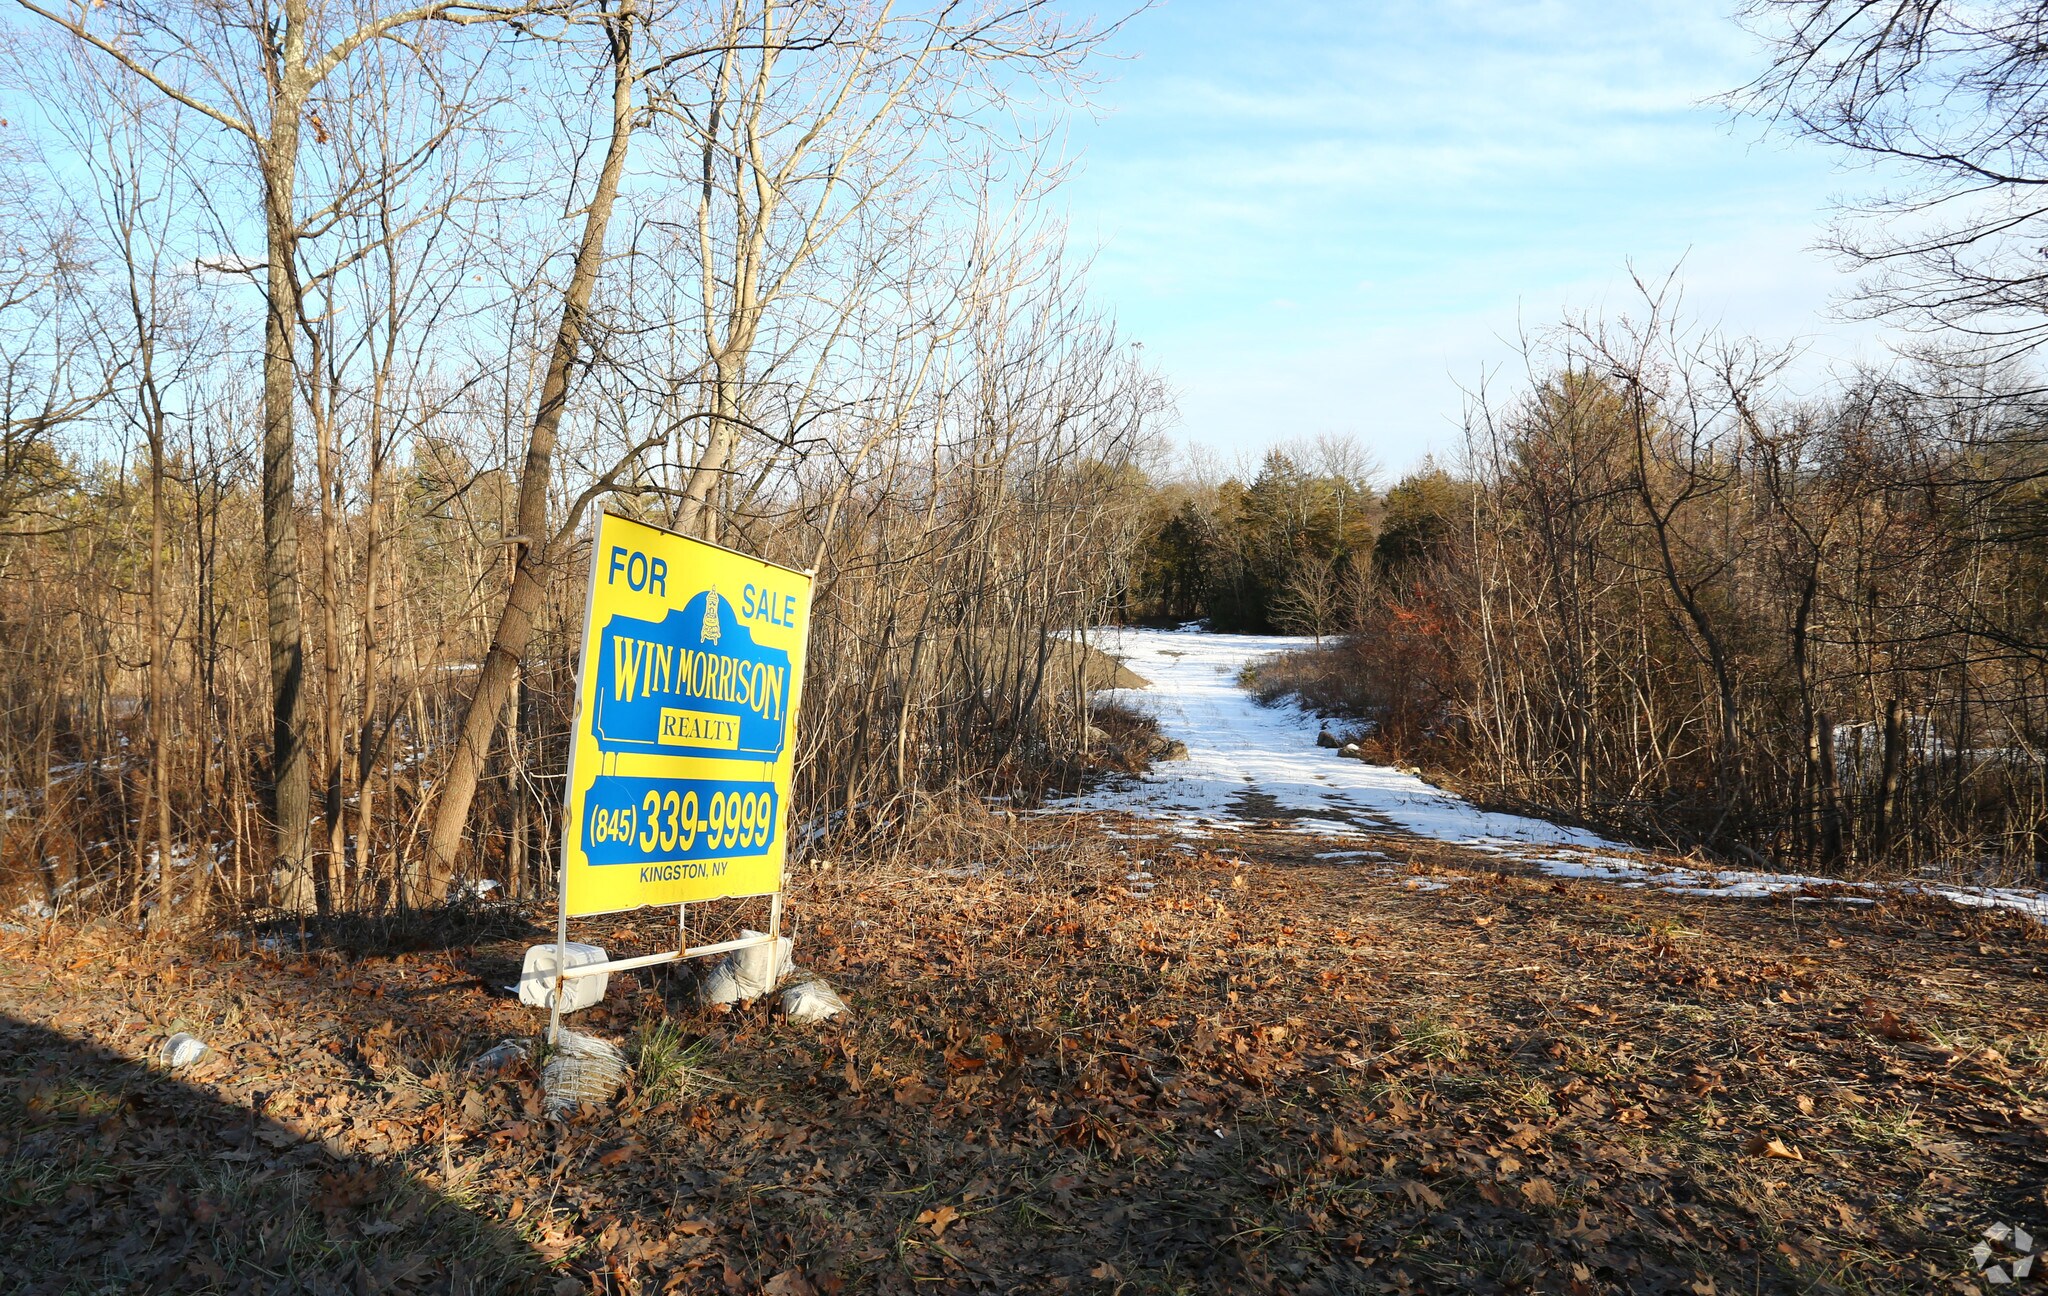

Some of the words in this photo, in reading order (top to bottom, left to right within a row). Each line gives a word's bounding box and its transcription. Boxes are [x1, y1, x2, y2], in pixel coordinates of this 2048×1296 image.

[608, 545, 667, 598] FOR
[741, 583, 796, 628] SALE
[613, 635, 674, 703] WIN
[675, 648, 785, 721] MORRISON
[662, 715, 737, 742] REALTY
[590, 803, 637, 848] (845)
[639, 790, 772, 853] 339-9999
[639, 863, 709, 883] KINGSTON,
[712, 862, 728, 877] NY
